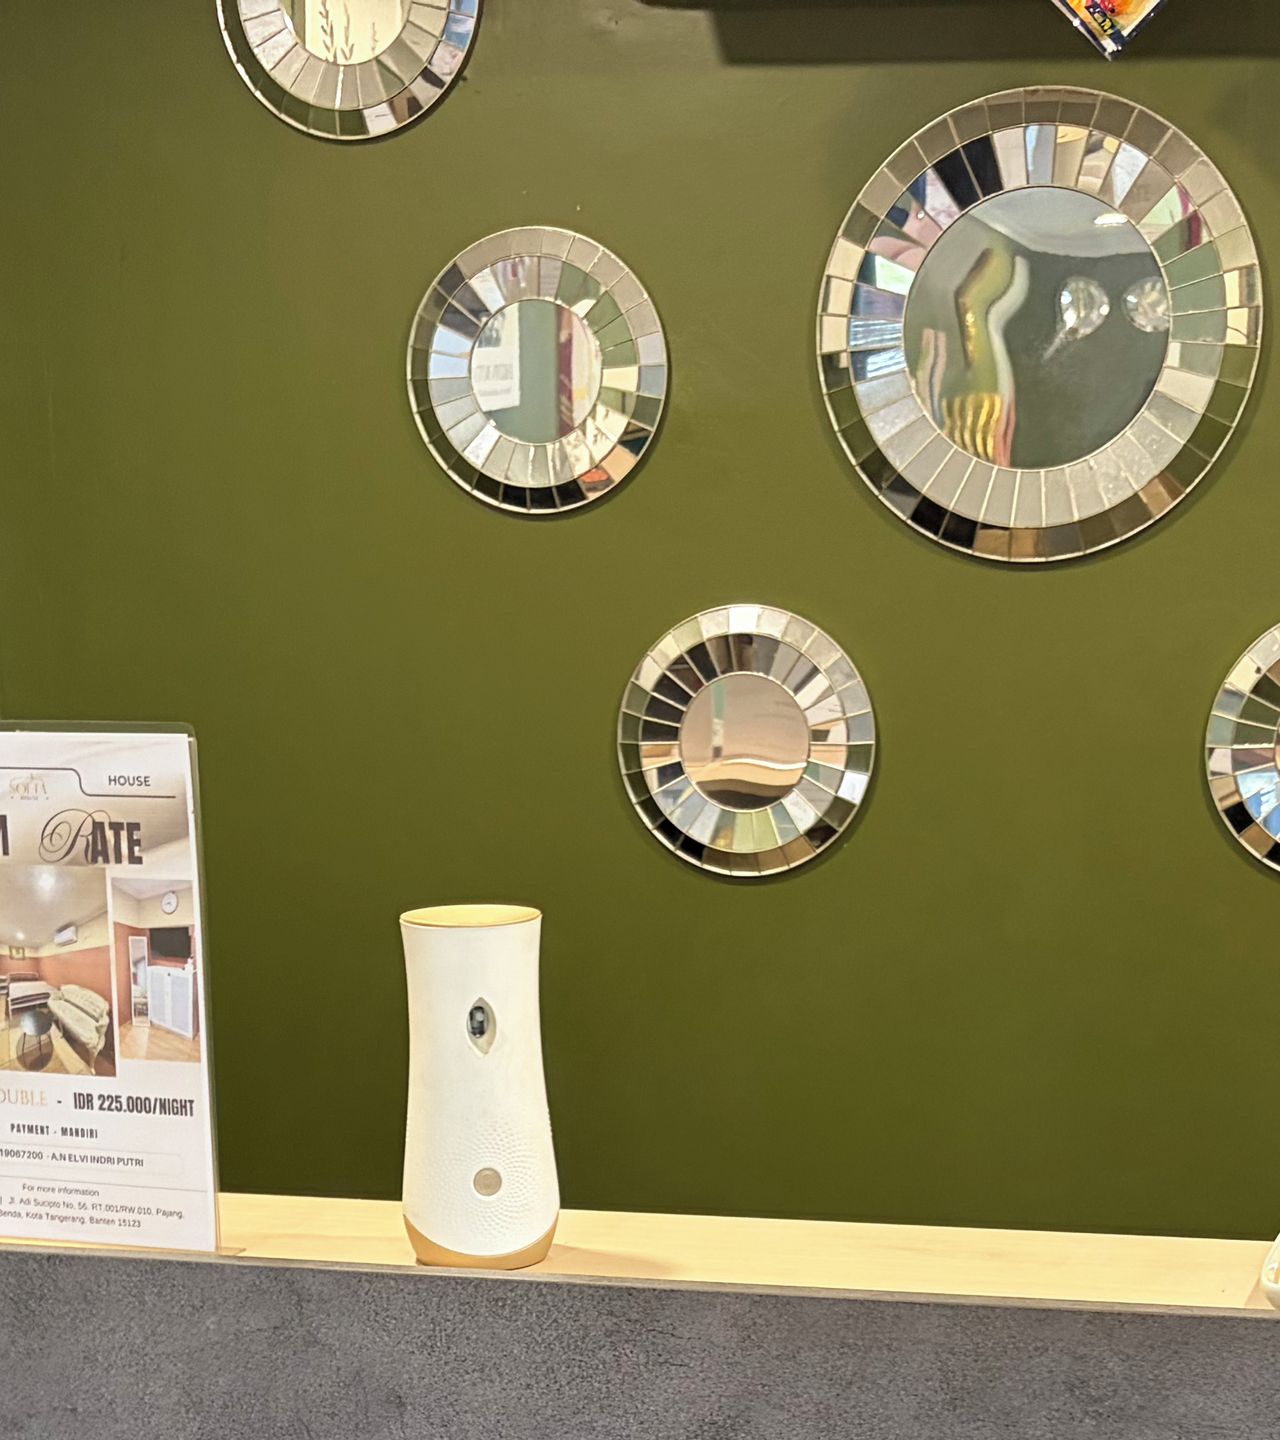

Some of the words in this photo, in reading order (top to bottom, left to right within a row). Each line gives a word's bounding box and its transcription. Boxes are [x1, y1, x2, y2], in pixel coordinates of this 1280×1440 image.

[108, 775, 151, 787] HOUSE
[39, 809, 143, 865] RATE
[74, 1092, 94, 1111] IDR
[98, 1094, 194, 1118] 225.000/NIGHT
[11, 1123, 49, 1136] PAYMENT
[61, 1126, 98, 1140] MANDIRI
[68, 1153, 88, 1164] ELVI
[117, 1156, 144, 1168] PUTRI
[22, 1182, 34, 1192] For
[37, 1186, 55, 1194] more
[58, 1186, 100, 1198] information
[26, 1210, 42, 1220] Kota
